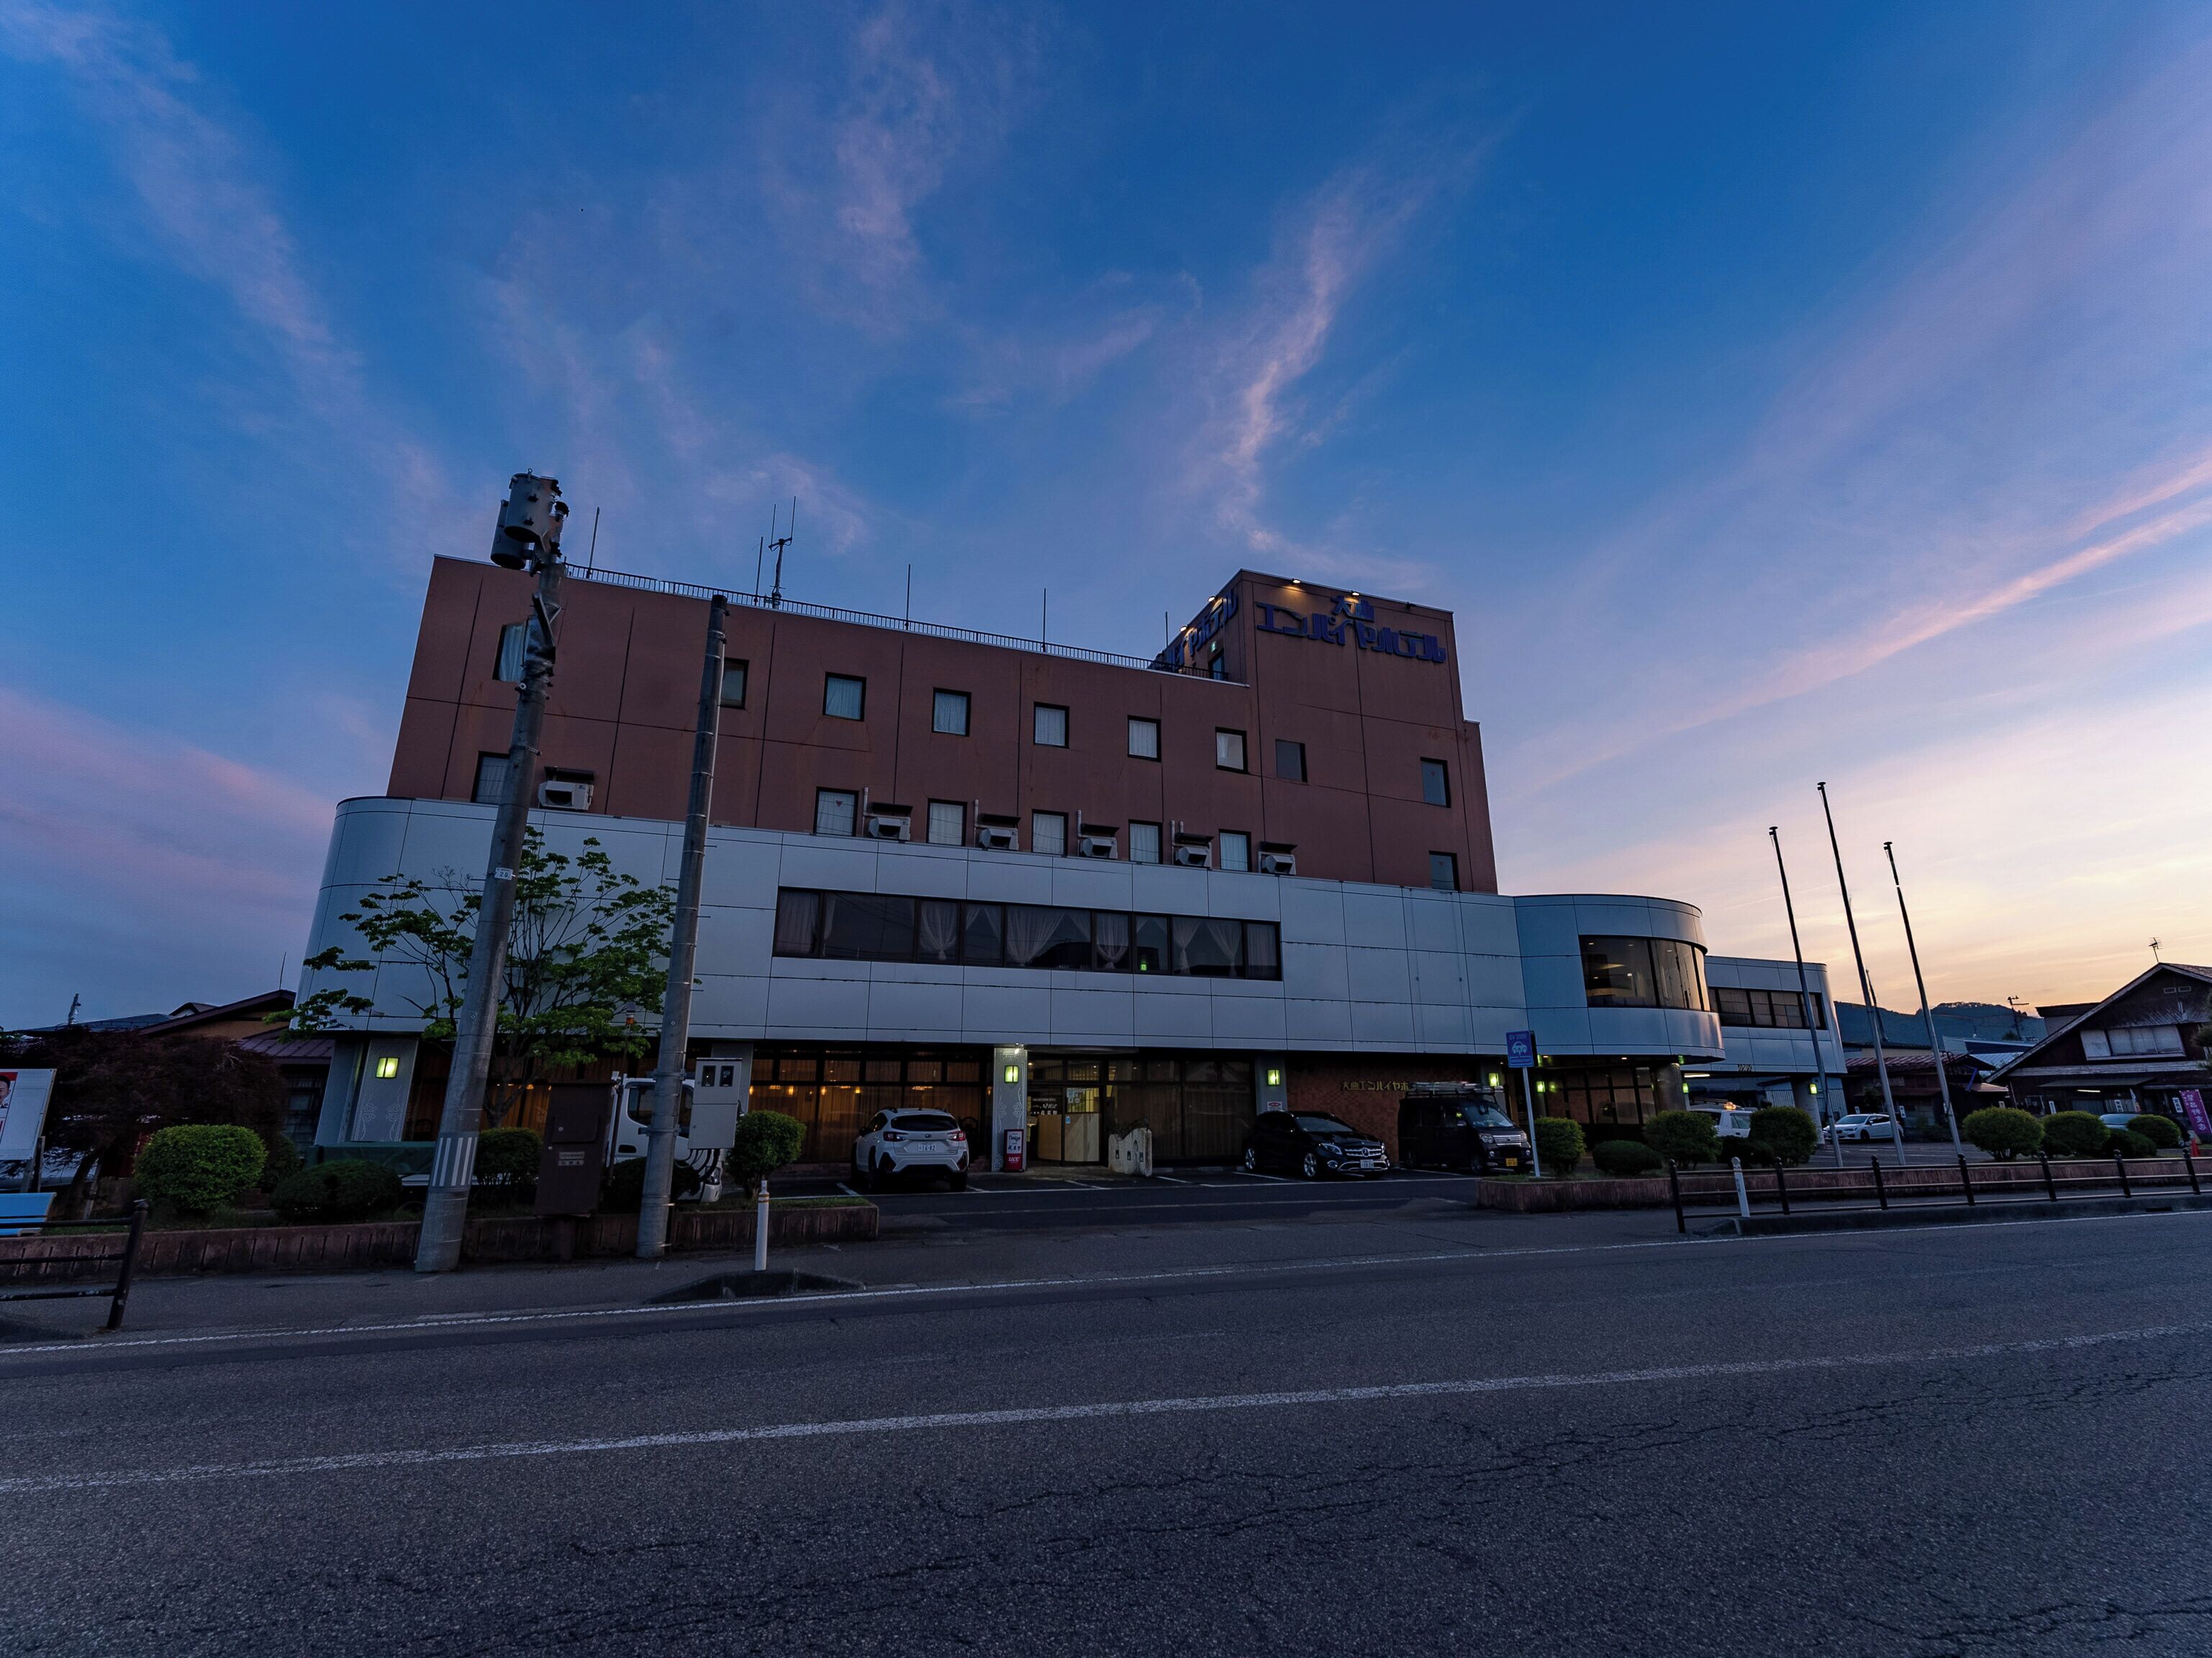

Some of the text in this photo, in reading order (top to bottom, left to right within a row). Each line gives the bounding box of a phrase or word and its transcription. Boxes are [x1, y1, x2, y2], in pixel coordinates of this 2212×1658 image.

[1331, 595, 1375, 622] 大曲
[1256, 602, 1446, 663] エンパイヤホテル
[1341, 1081, 1410, 1092] 大曲エンパイヤホ
